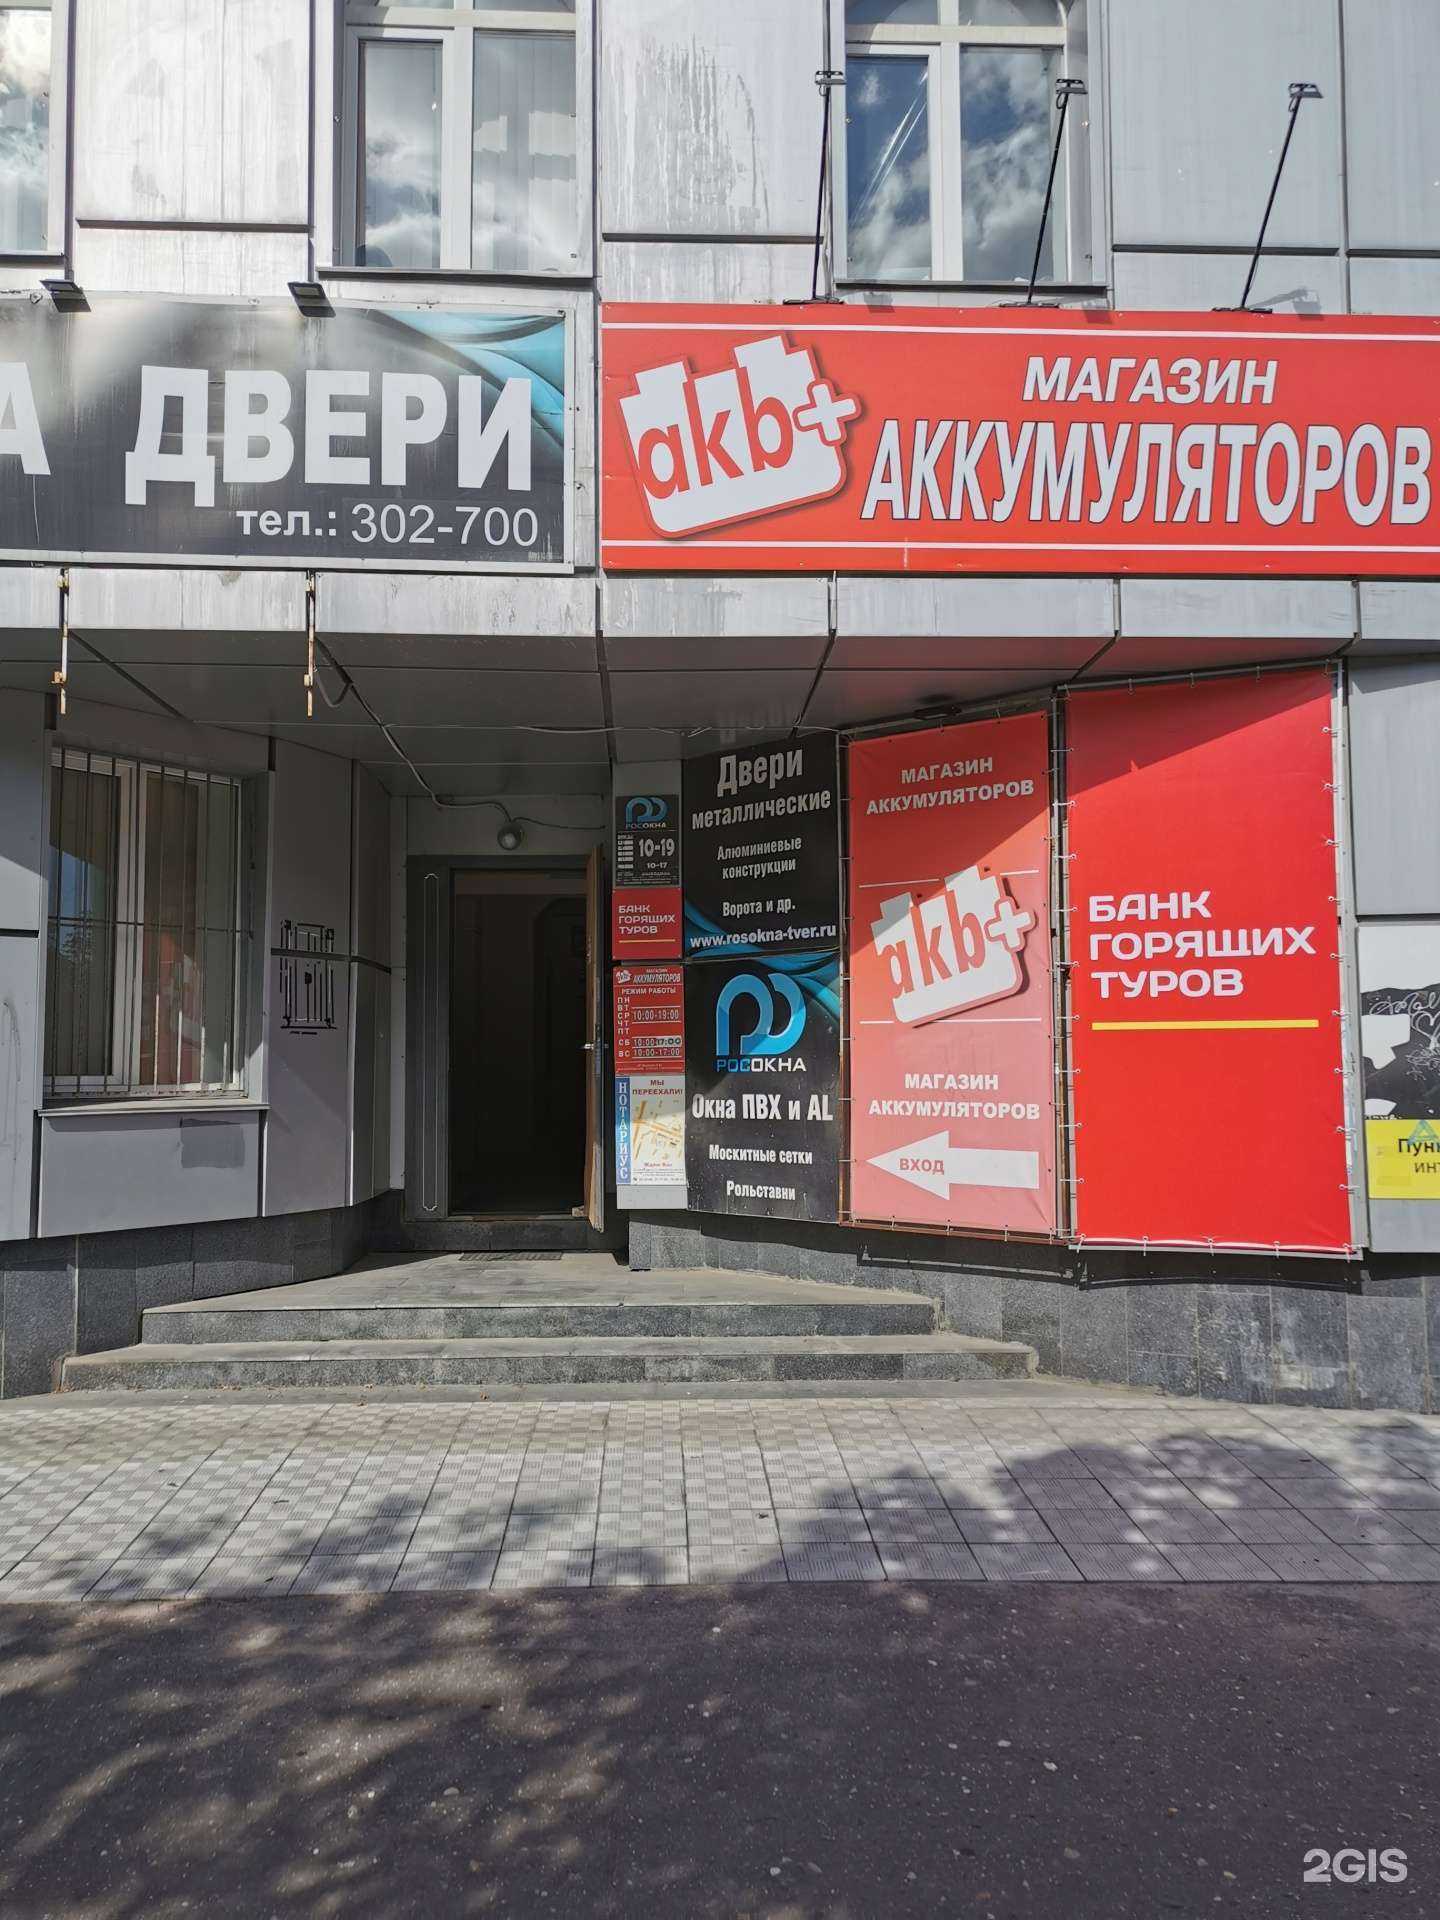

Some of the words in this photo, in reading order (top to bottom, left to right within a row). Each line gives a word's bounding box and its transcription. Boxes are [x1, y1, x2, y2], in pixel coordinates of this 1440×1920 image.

[1022, 356, 1279, 405] МАГАЗИН
[125, 365, 532, 507] ДВЕРИ
[859, 418, 1433, 528] АККУМУЛЯТОРОВ
[236, 508, 338, 537] тел.:
[351, 503, 538, 547] 302-700
[717, 749, 803, 797] Двери
[901, 757, 993, 784] МАГАЗИН
[866, 779, 1035, 815] АККУМУЛЯТОРОВ
[692, 789, 831, 830] металлические
[639, 838, 675, 857] 10-19
[717, 837, 802, 861] Алюминиевые
[722, 858, 796, 880] конструкции
[618, 905, 651, 914] БАНК
[722, 901, 763, 919] Ворота
[766, 900, 774, 912] и
[777, 898, 796, 915] др.
[1089, 890, 1212, 922] БАНК
[618, 914, 676, 924] ГОРЯЩИХ
[618, 925, 658, 935] ТУРОВ
[690, 925, 837, 948] www.rosokna-tver.ru
[1089, 926, 1316, 961] ГОРЯЩИХ
[1091, 968, 1244, 999] ТУРОВ
[716, 1057, 807, 1073] РОСОКНА
[904, 1073, 999, 1090] МАГАЗИН
[692, 1093, 736, 1119] Окна
[742, 1094, 782, 1121] ПВХ
[788, 1100, 801, 1121] и
[868, 1099, 1041, 1120] АККУМУЛЯТОРОВ
[618, 1082, 629, 1180] НОТАРИУС
[709, 1144, 776, 1164] Москитные
[779, 1150, 813, 1165] сетки
[899, 1158, 945, 1176] ВХОД
[726, 1180, 796, 1200] Рольставни
